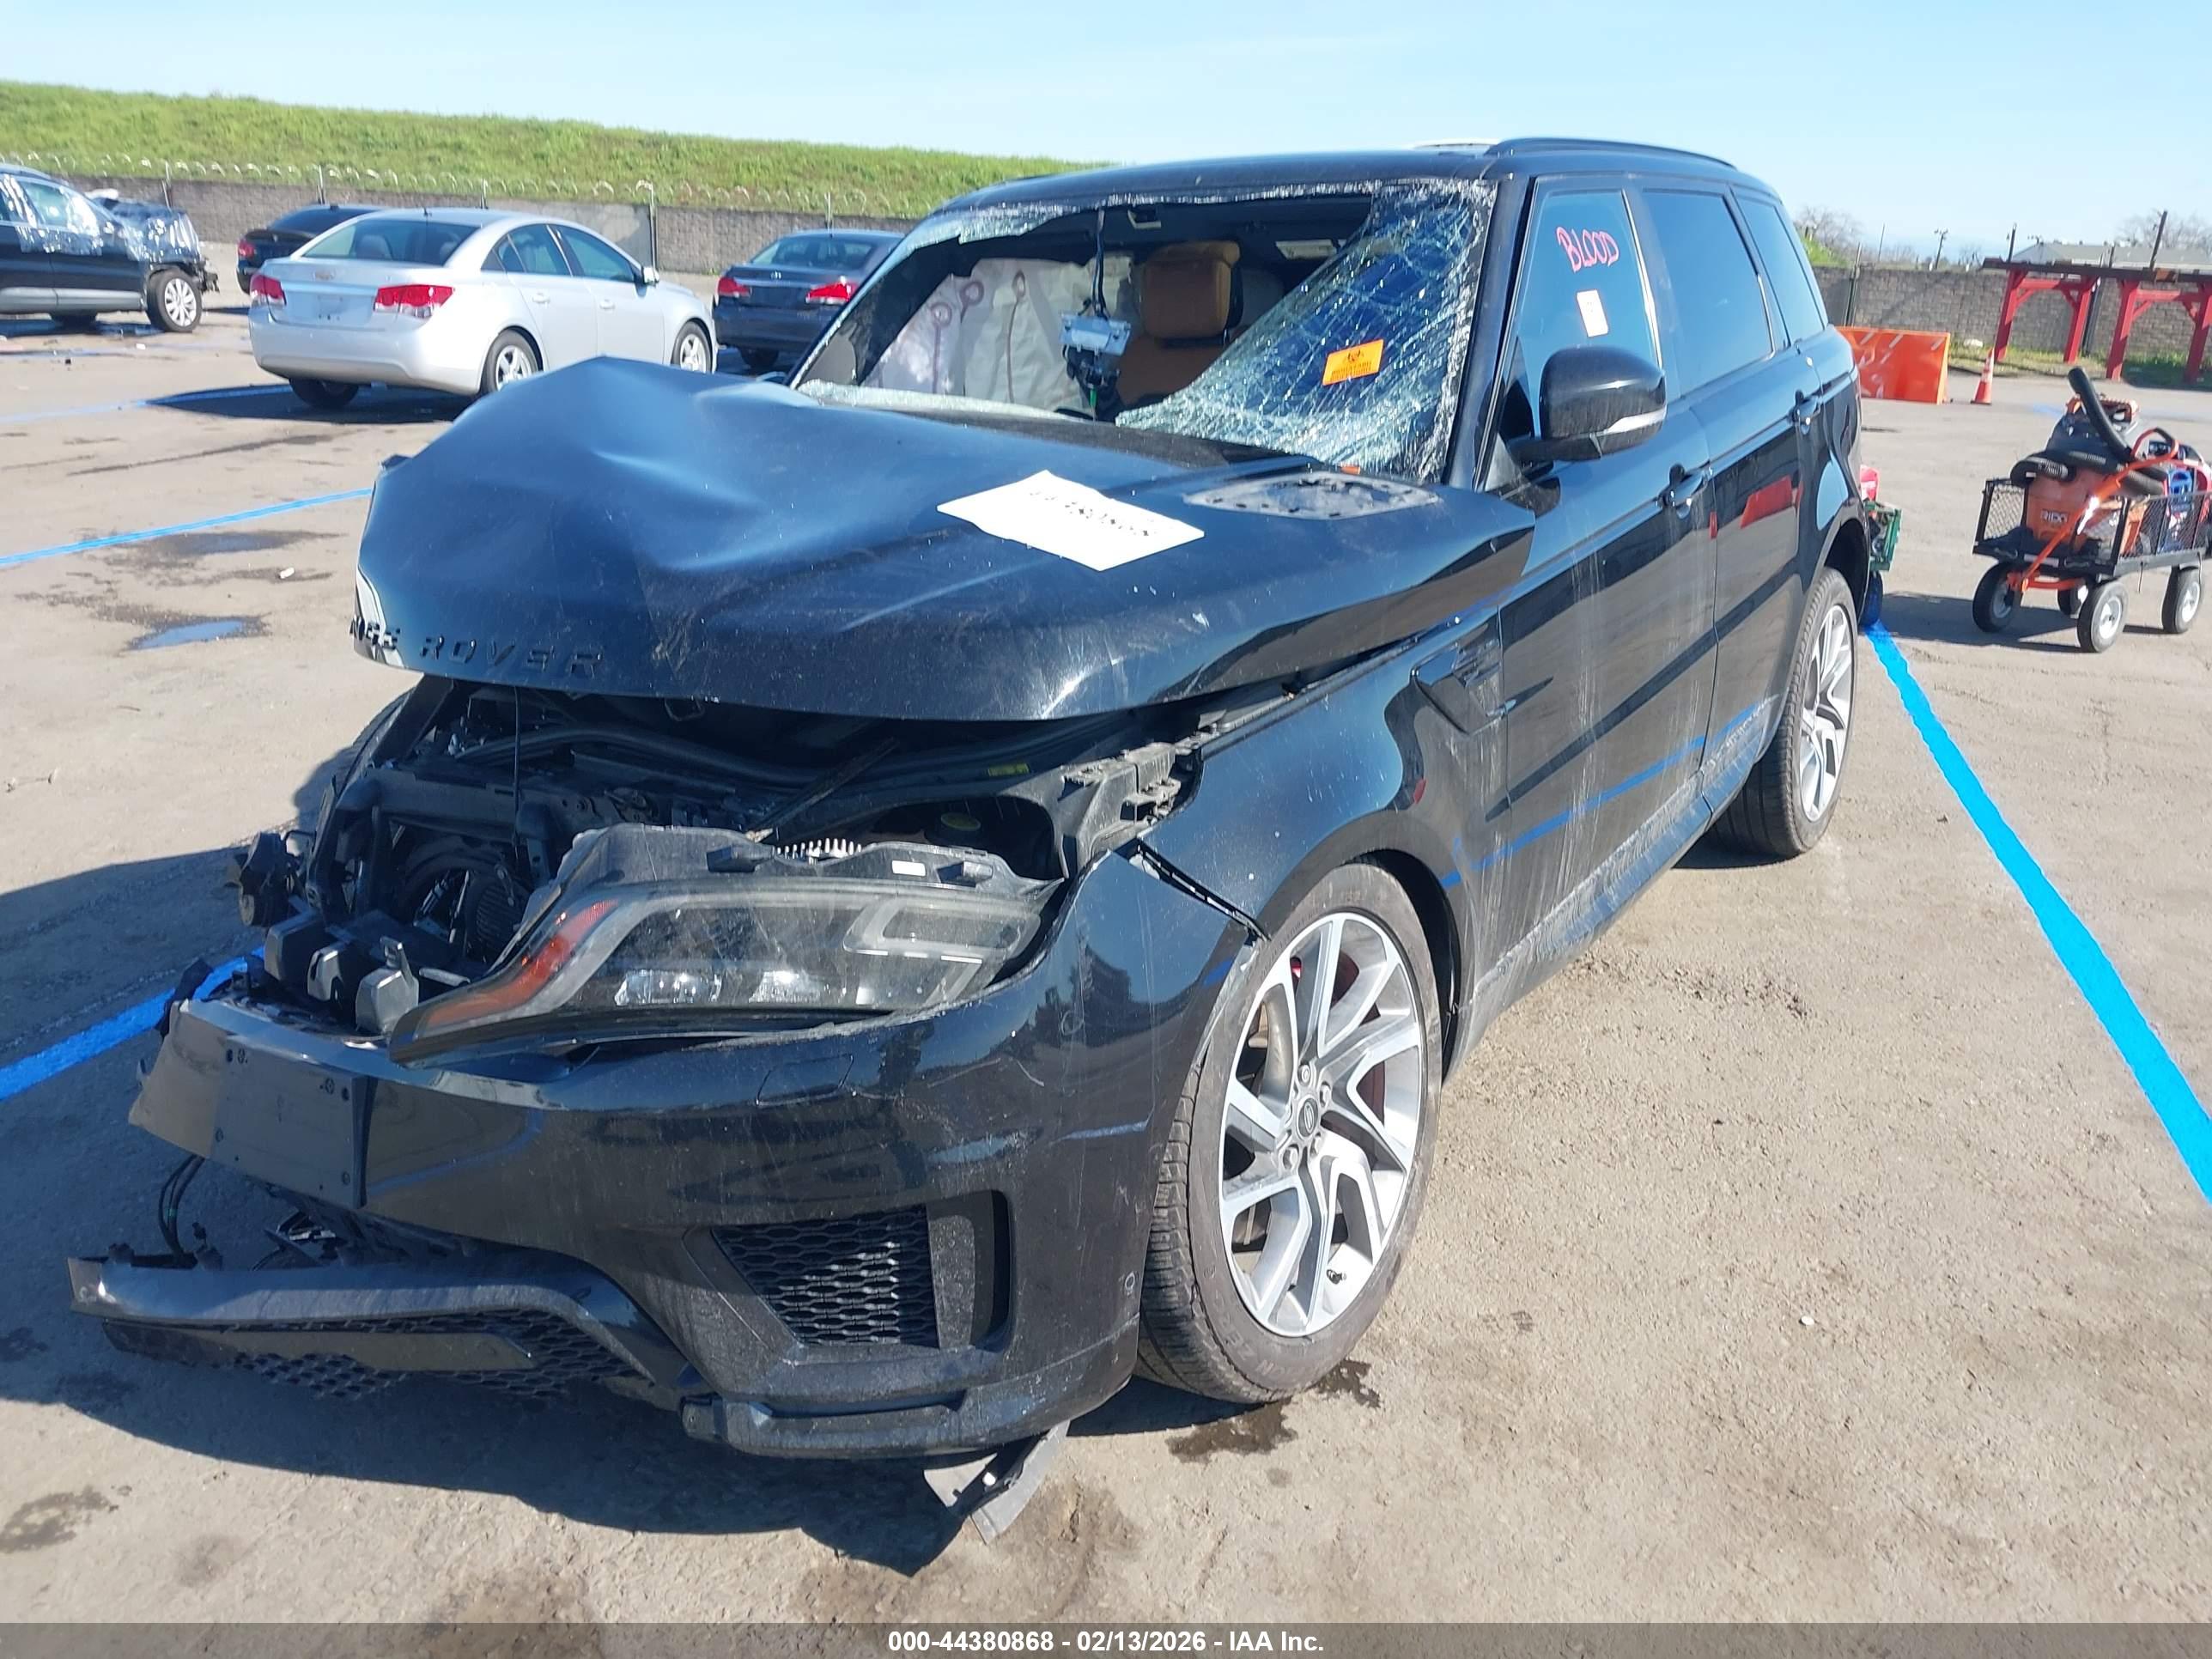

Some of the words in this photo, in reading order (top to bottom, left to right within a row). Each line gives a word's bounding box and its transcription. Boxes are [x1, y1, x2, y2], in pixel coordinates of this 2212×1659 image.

[1556, 226, 1620, 273] BLOOD
[349, 615, 401, 650] NGE
[419, 635, 605, 679] ROVER
